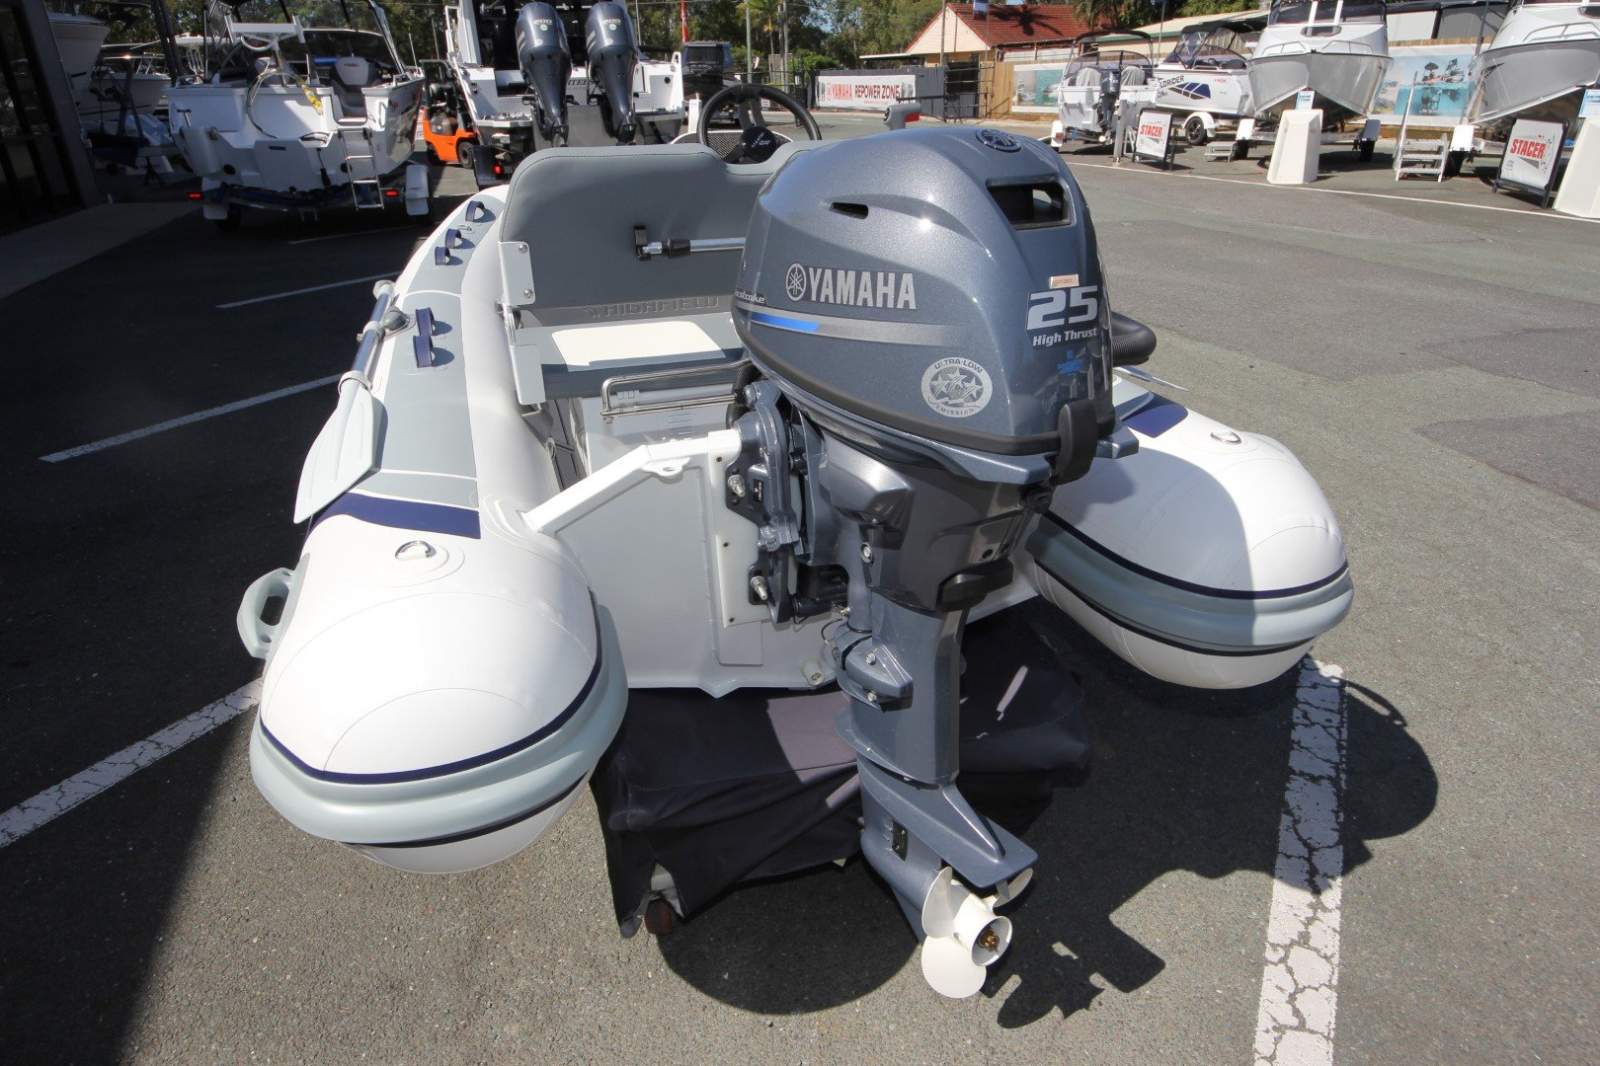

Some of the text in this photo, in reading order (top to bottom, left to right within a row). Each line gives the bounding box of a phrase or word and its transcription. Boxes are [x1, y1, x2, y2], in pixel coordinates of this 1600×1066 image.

[855, 84, 880, 99] REPOWER
[881, 84, 900, 99] ZONE
[1510, 138, 1547, 159] STACER
[808, 267, 917, 310] YAMAHA
[1026, 285, 1098, 330] 25
[1032, 327, 1098, 347] High Thrust
